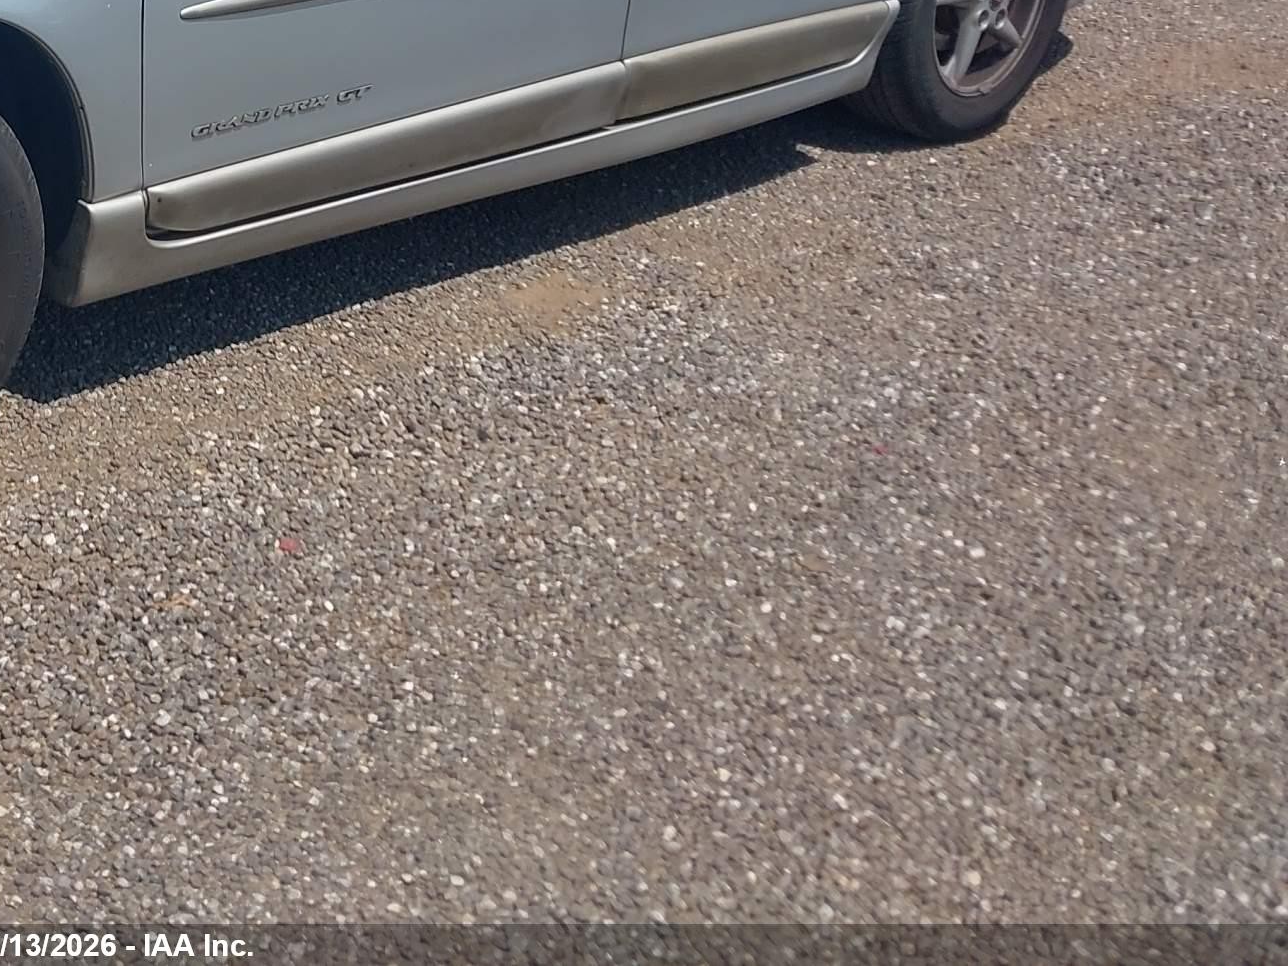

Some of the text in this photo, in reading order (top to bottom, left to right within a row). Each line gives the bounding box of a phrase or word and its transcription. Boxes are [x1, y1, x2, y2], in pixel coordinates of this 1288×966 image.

[191, 84, 374, 139] GRAND PRIX GT
